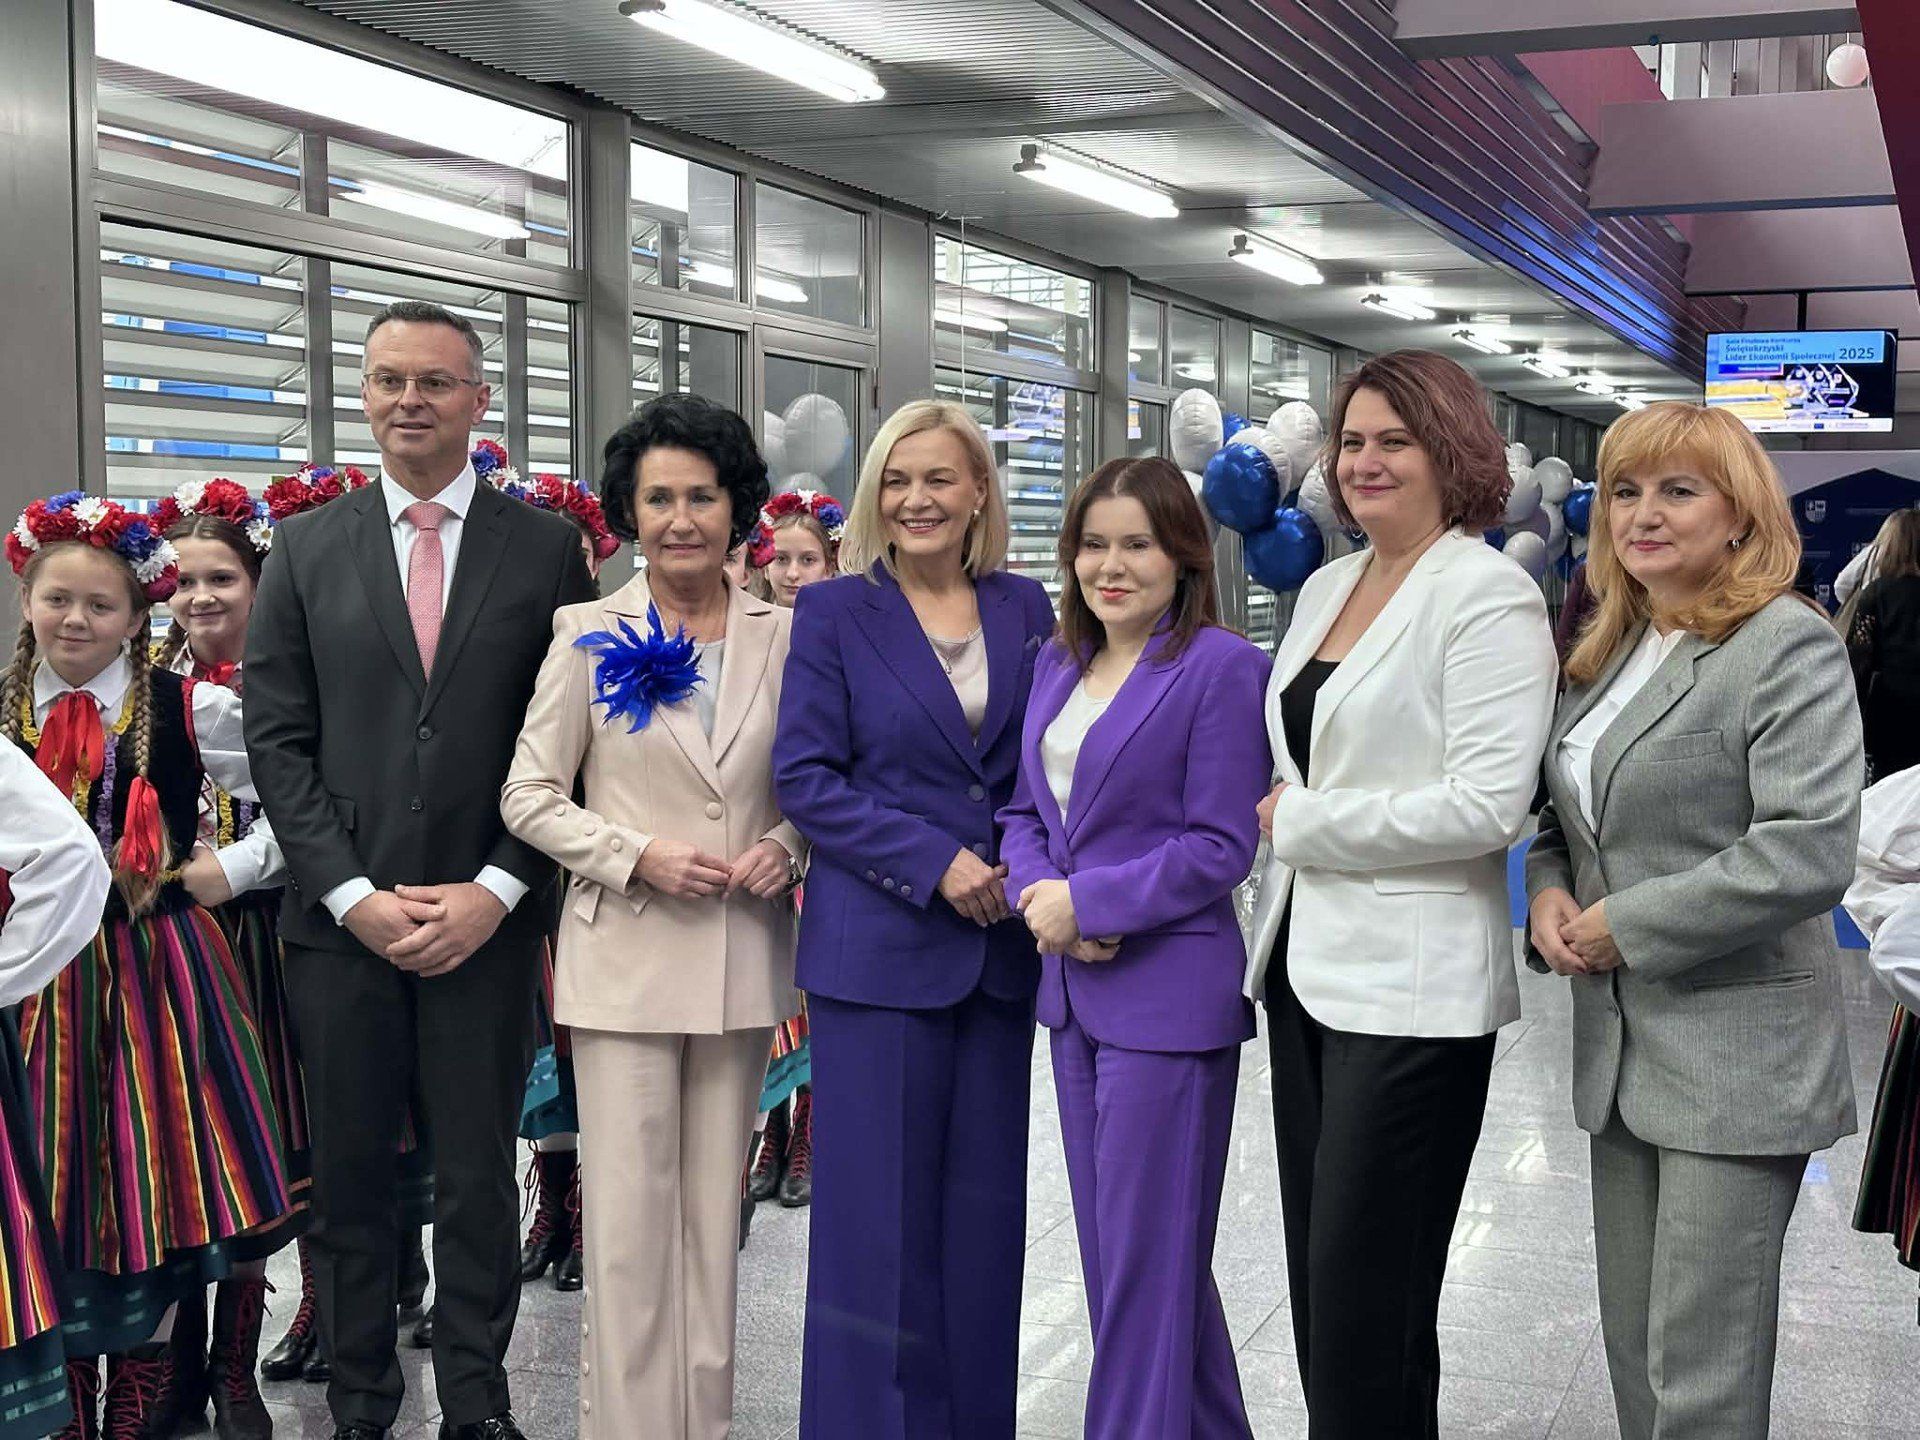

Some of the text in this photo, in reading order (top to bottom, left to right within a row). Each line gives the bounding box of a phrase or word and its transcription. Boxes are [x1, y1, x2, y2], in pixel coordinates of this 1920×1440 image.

[1725, 344, 1784, 353] Świętokrzyski
[1725, 353, 1747, 361] Lider
[1749, 353, 1789, 361] Ekonomii
[1839, 347, 1875, 360] 2025
